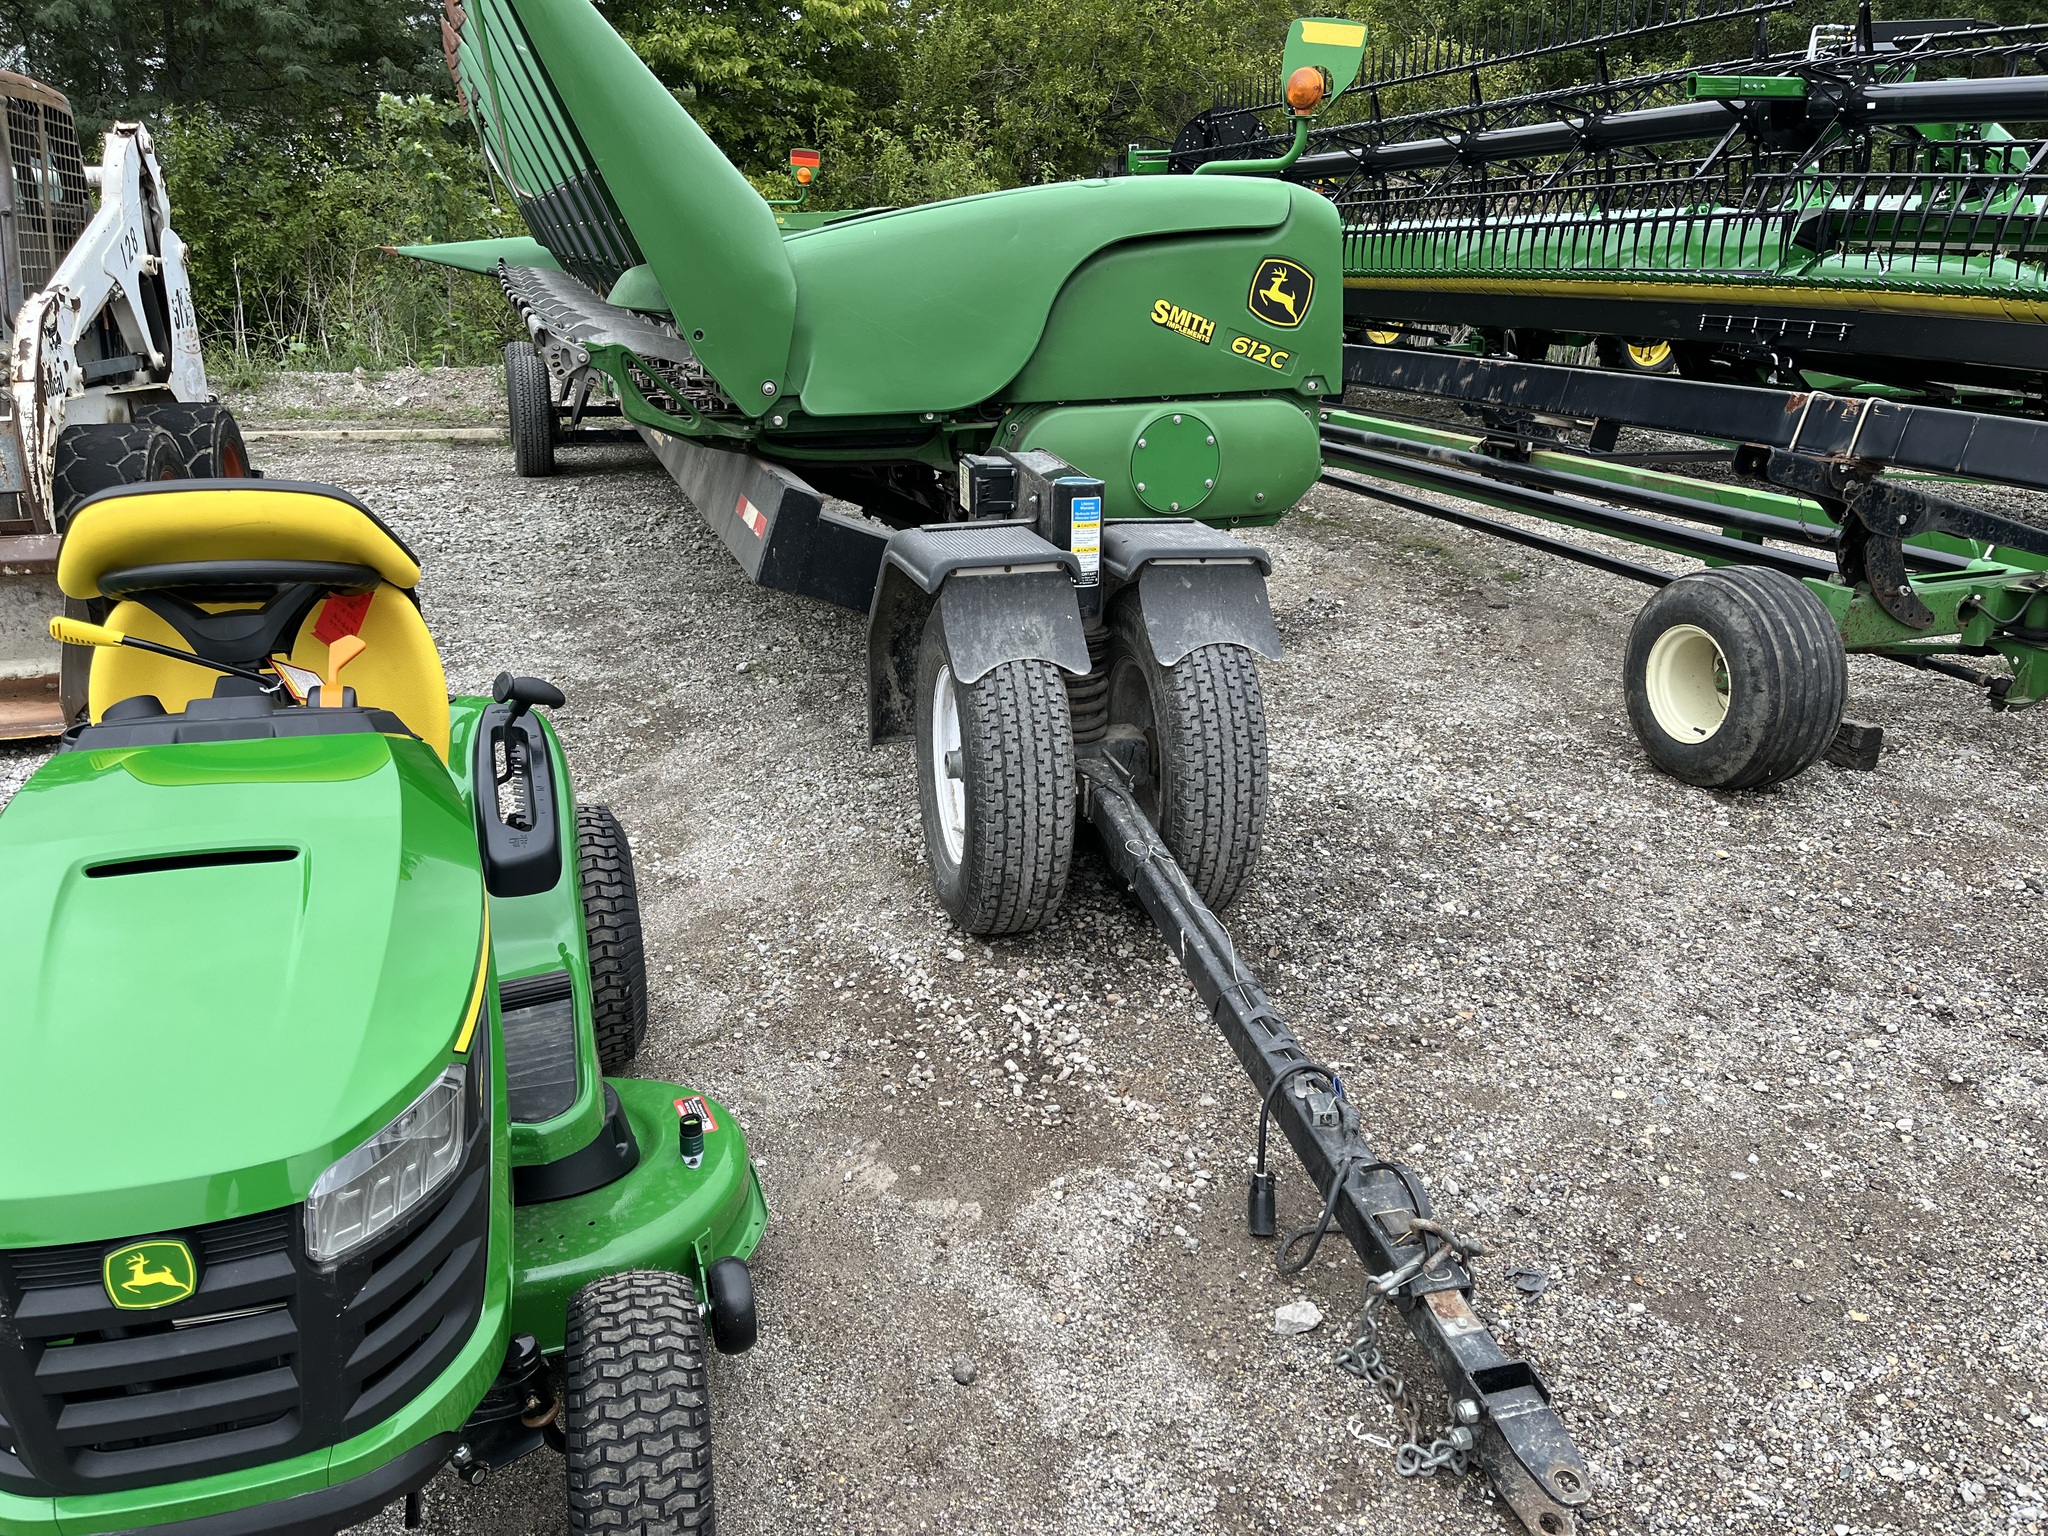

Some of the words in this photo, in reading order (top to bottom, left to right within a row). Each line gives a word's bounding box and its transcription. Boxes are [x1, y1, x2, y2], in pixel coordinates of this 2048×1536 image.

[120, 227, 138, 270] 128
[1150, 299, 1217, 338] SMITH
[1166, 320, 1211, 344] IMPLEMENTS
[1231, 336, 1290, 369] 612C
